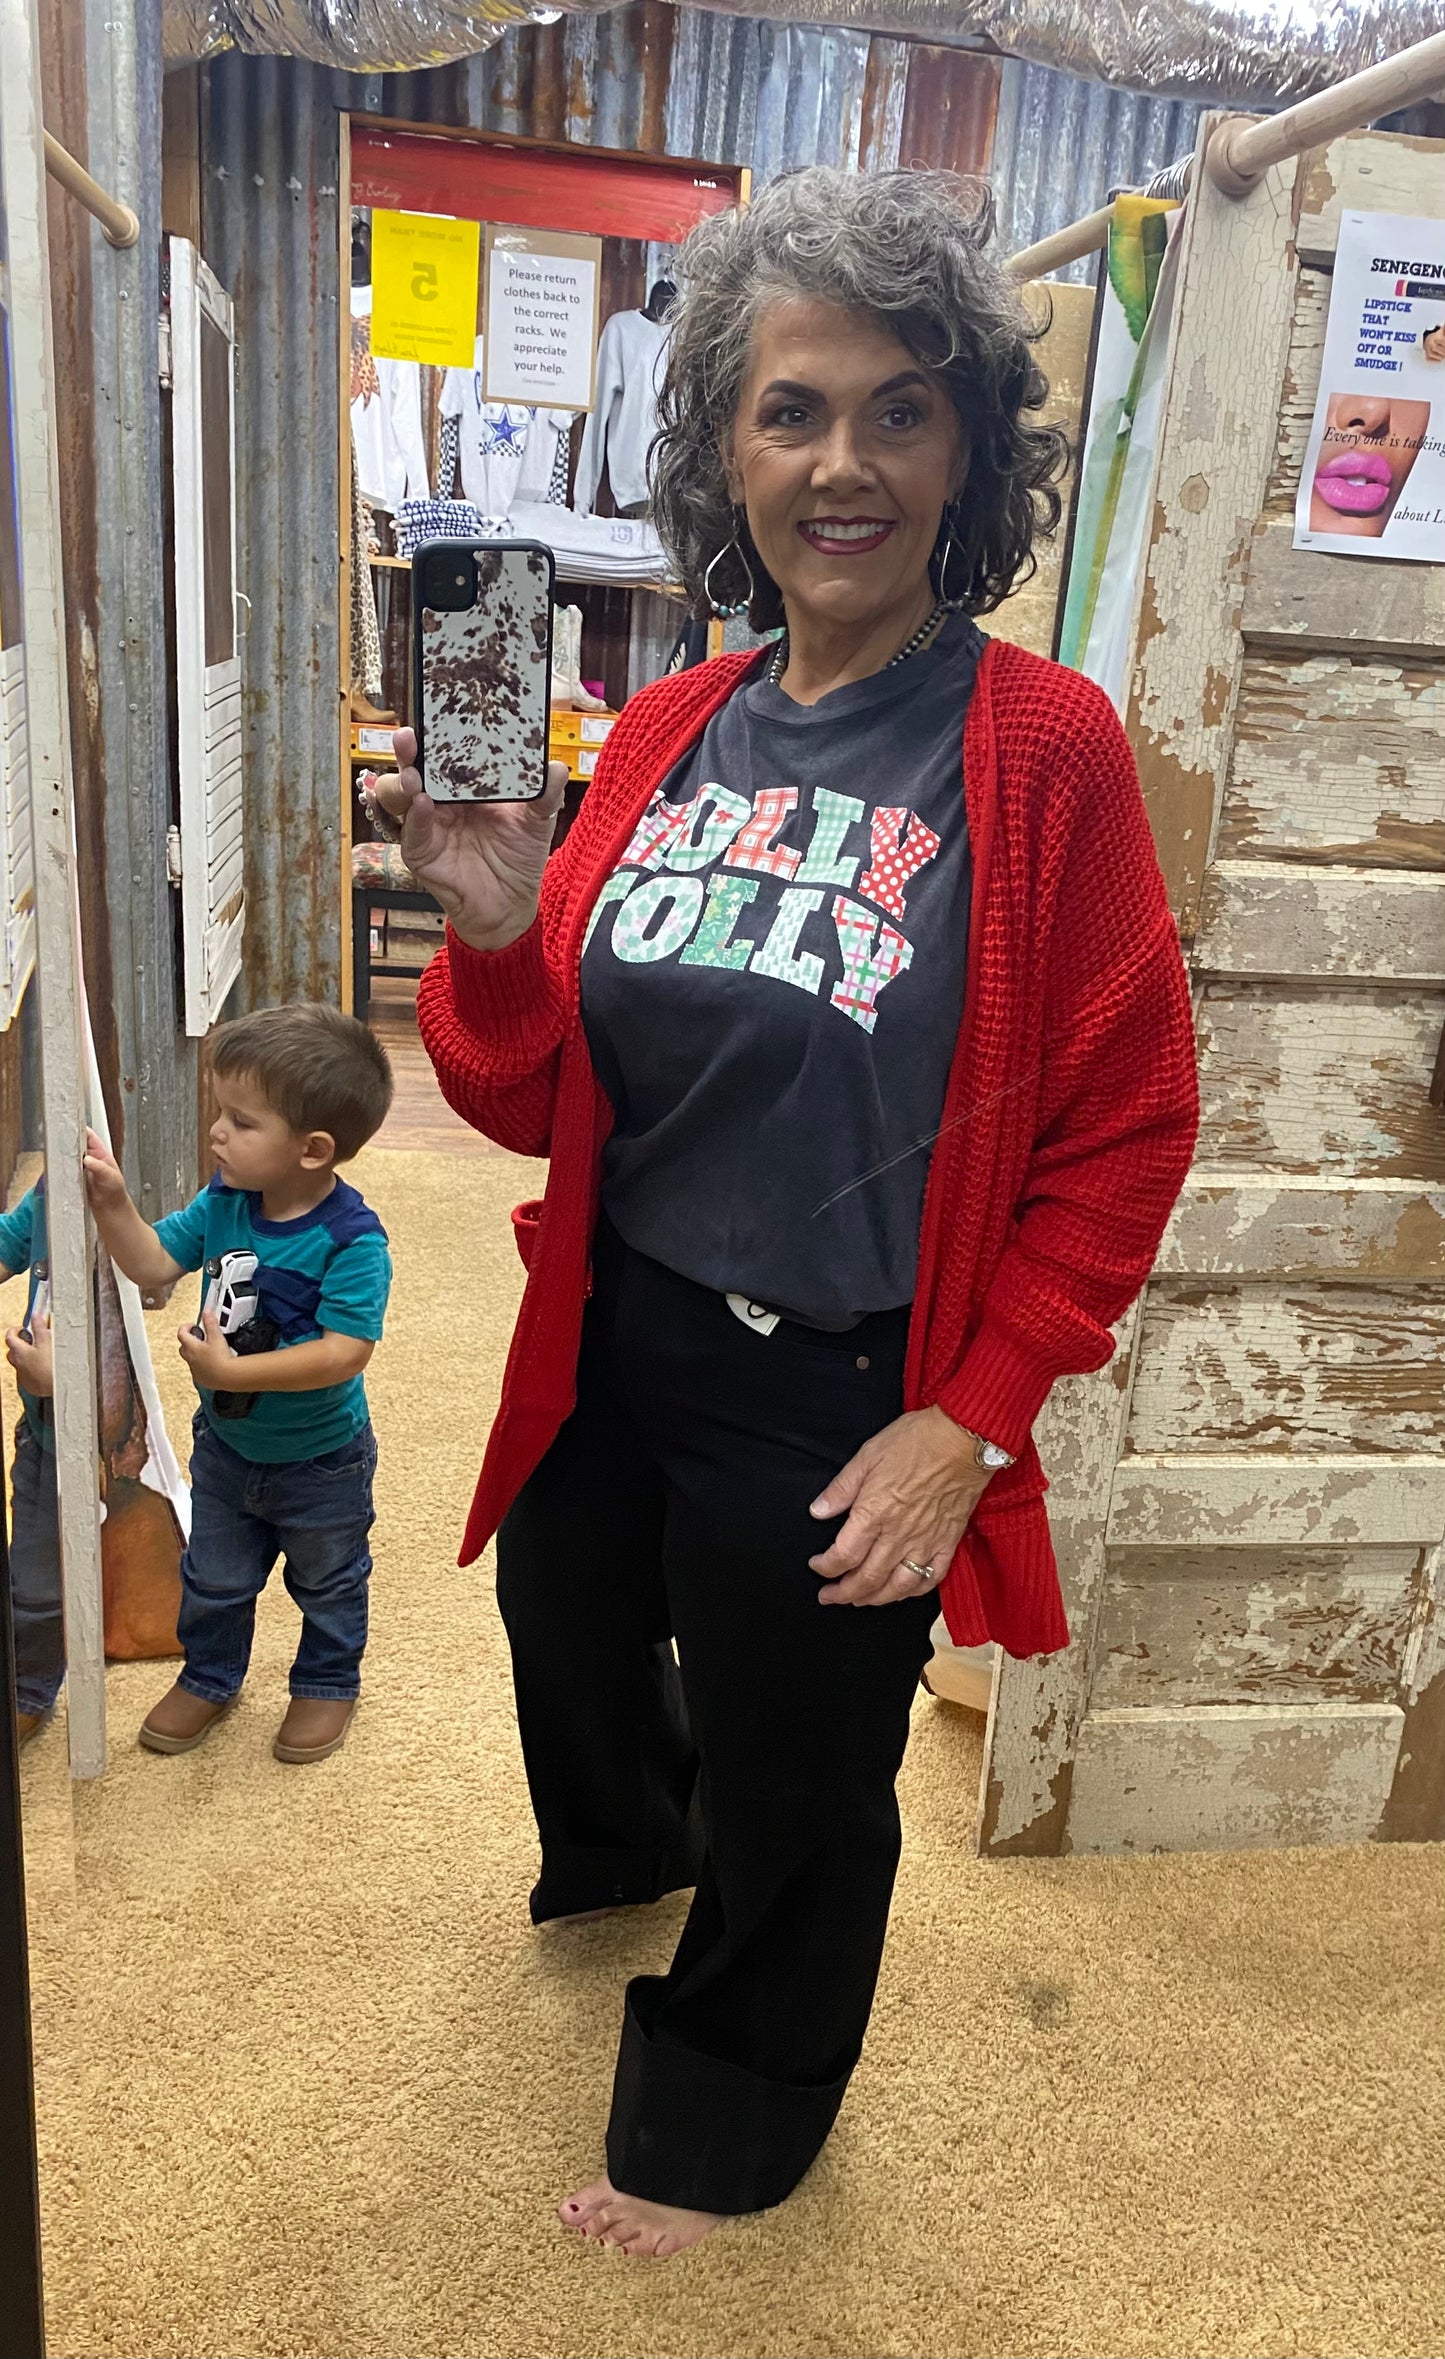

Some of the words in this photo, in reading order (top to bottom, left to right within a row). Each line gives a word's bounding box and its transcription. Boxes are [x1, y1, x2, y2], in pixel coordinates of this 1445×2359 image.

[1371, 258, 1445, 279] SENEGEN
[508, 268, 541, 281] Please
[544, 274, 577, 285] return
[503, 286, 541, 300] clothes
[543, 290, 567, 303] back
[569, 294, 581, 304] to
[1364, 298, 1413, 313] LIPSTICK
[513, 306, 532, 317] the
[533, 309, 569, 321] correct
[1362, 313, 1390, 326] THAT
[514, 324, 545, 337] racks.
[549, 327, 567, 339] We
[1359, 327, 1394, 341] WON'T
[1393, 331, 1417, 343] KISS
[512, 342, 568, 357] appreciate
[1357, 342, 1377, 354] OFF
[1377, 345, 1393, 356] OR
[513, 361, 538, 373] your
[539, 361, 566, 376] help.
[1354, 357, 1398, 371] SMUDGE
[1323, 426, 1361, 449] Every
[1363, 435, 1385, 447] one
[1389, 433, 1400, 447] is
[1393, 506, 1431, 523] about
[1433, 508, 1445, 524] L
